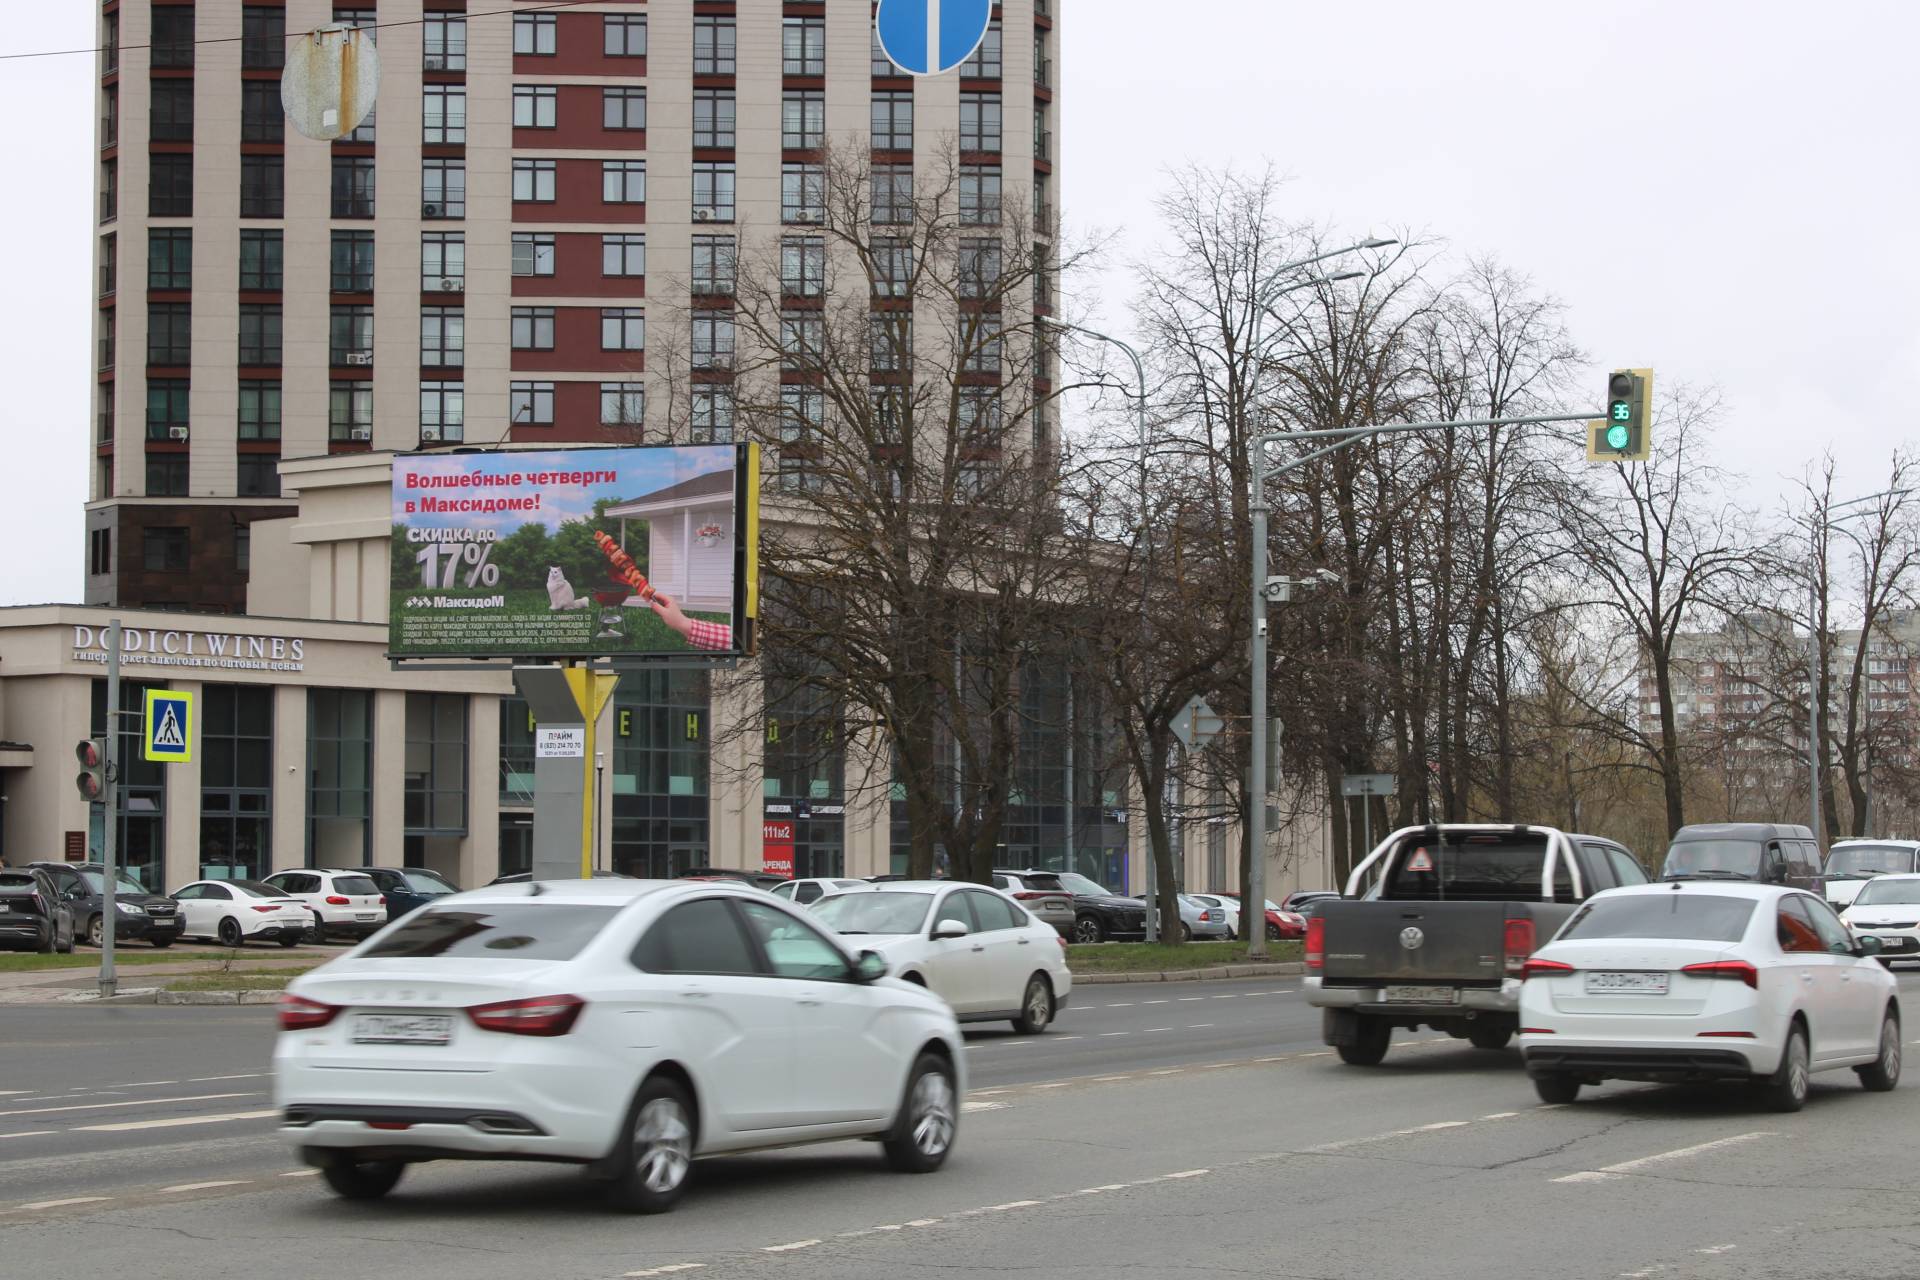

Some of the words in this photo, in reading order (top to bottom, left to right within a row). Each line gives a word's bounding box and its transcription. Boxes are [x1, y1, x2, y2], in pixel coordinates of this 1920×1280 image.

[406, 470, 522, 489] Волшебные
[526, 471, 617, 487] четверги
[405, 501, 416, 513] в
[420, 494, 541, 513] Максидоме!
[407, 528, 474, 543] СКИДКА
[416, 543, 500, 589] 17%
[205, 633, 304, 660] WINES
[151, 655, 201, 667] алкоголя
[204, 658, 218, 666] по
[219, 659, 268, 670] оптовым
[271, 660, 304, 671] ценам
[548, 731, 573, 740] ПРАЙМ
